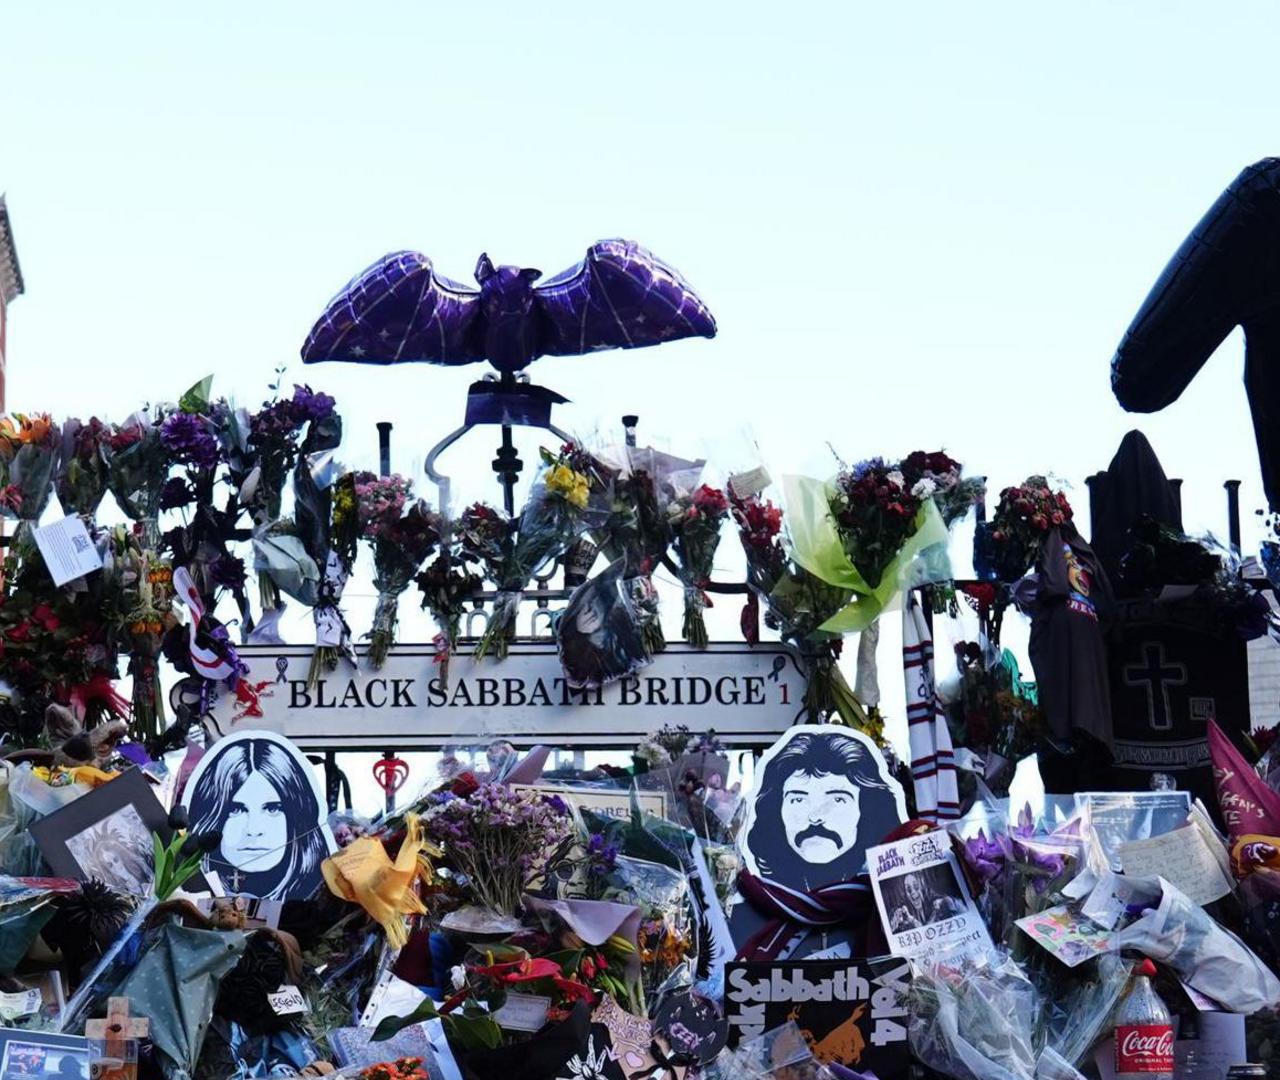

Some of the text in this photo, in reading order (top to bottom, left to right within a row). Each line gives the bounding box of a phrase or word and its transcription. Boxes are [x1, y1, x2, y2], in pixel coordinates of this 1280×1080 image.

[288, 677, 792, 709] BLACK SABBATH BRIDGE 1
[728, 966, 870, 1002] Sabbath
